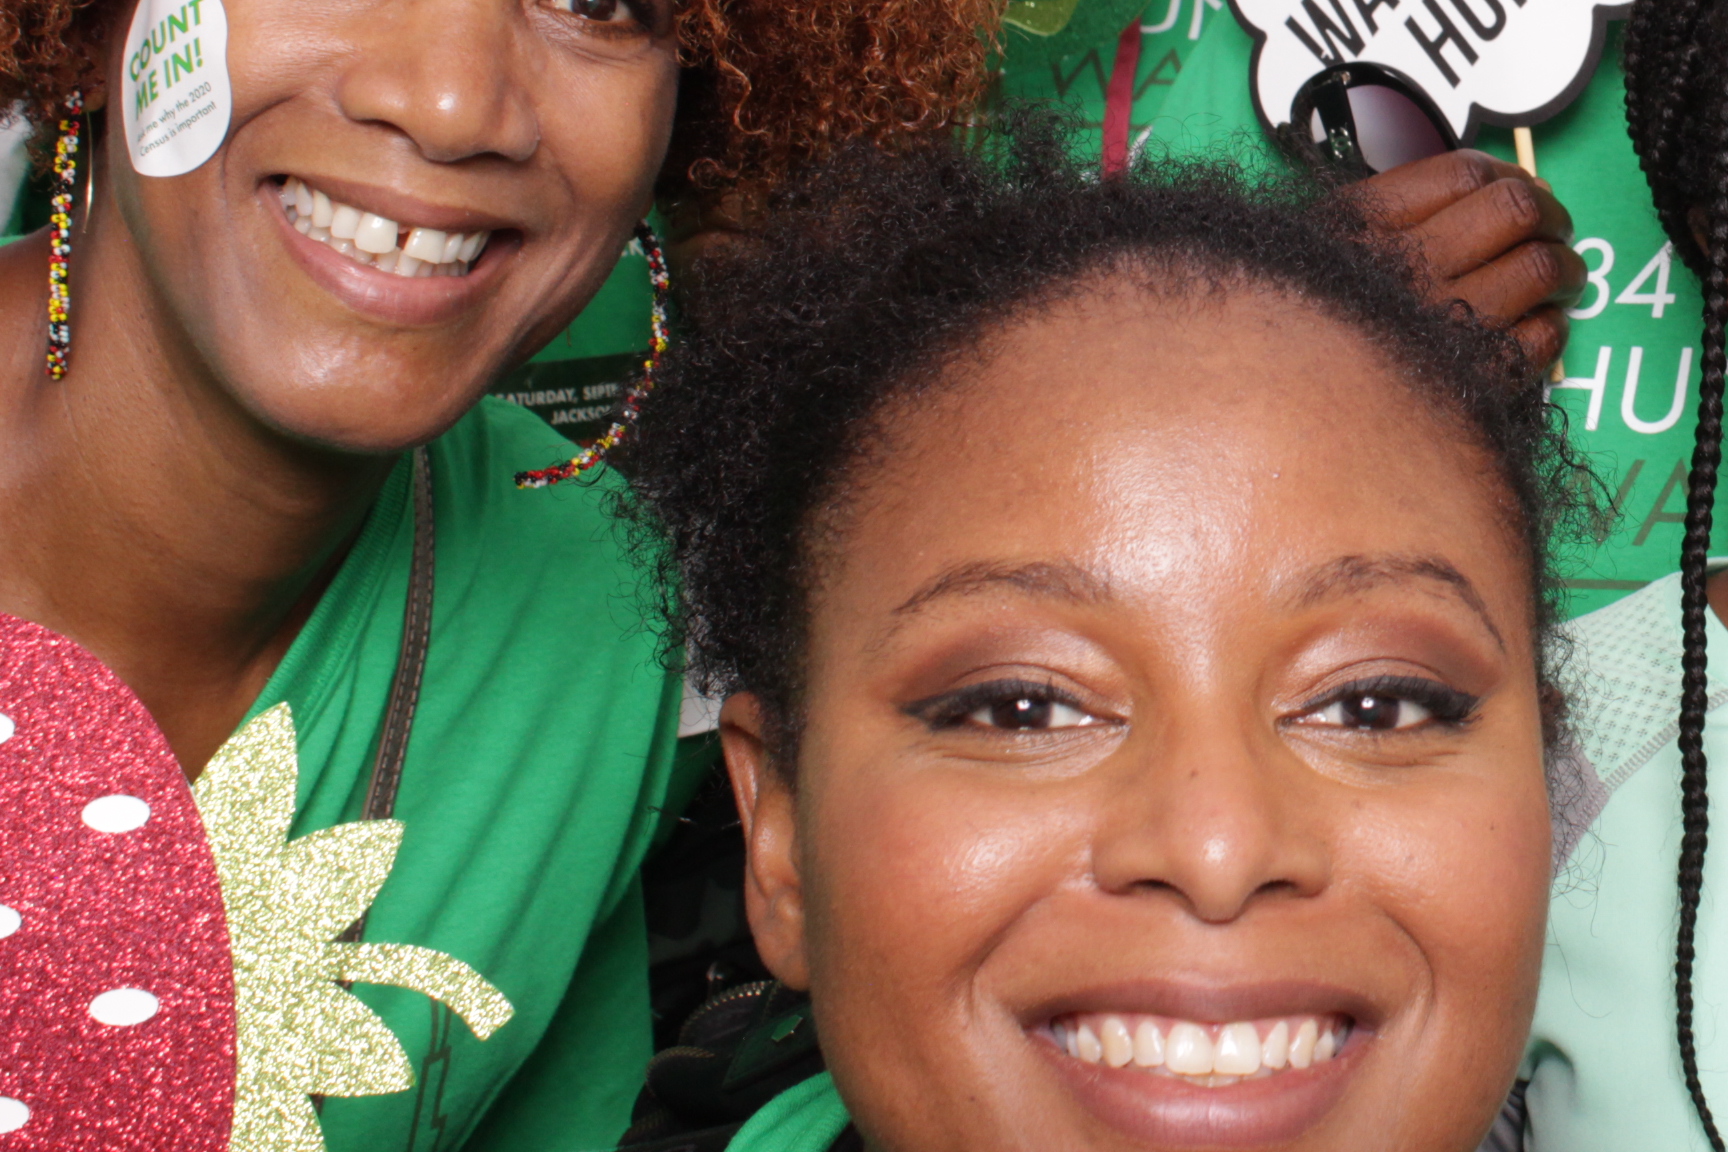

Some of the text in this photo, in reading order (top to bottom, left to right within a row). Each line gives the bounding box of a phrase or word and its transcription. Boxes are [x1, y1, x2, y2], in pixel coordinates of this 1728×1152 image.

[134, 36, 204, 122] ME IN!
[159, 109, 175, 123] why
[176, 99, 189, 112] the
[189, 81, 212, 102] 2020
[168, 127, 177, 138] is
[175, 100, 217, 133] important
